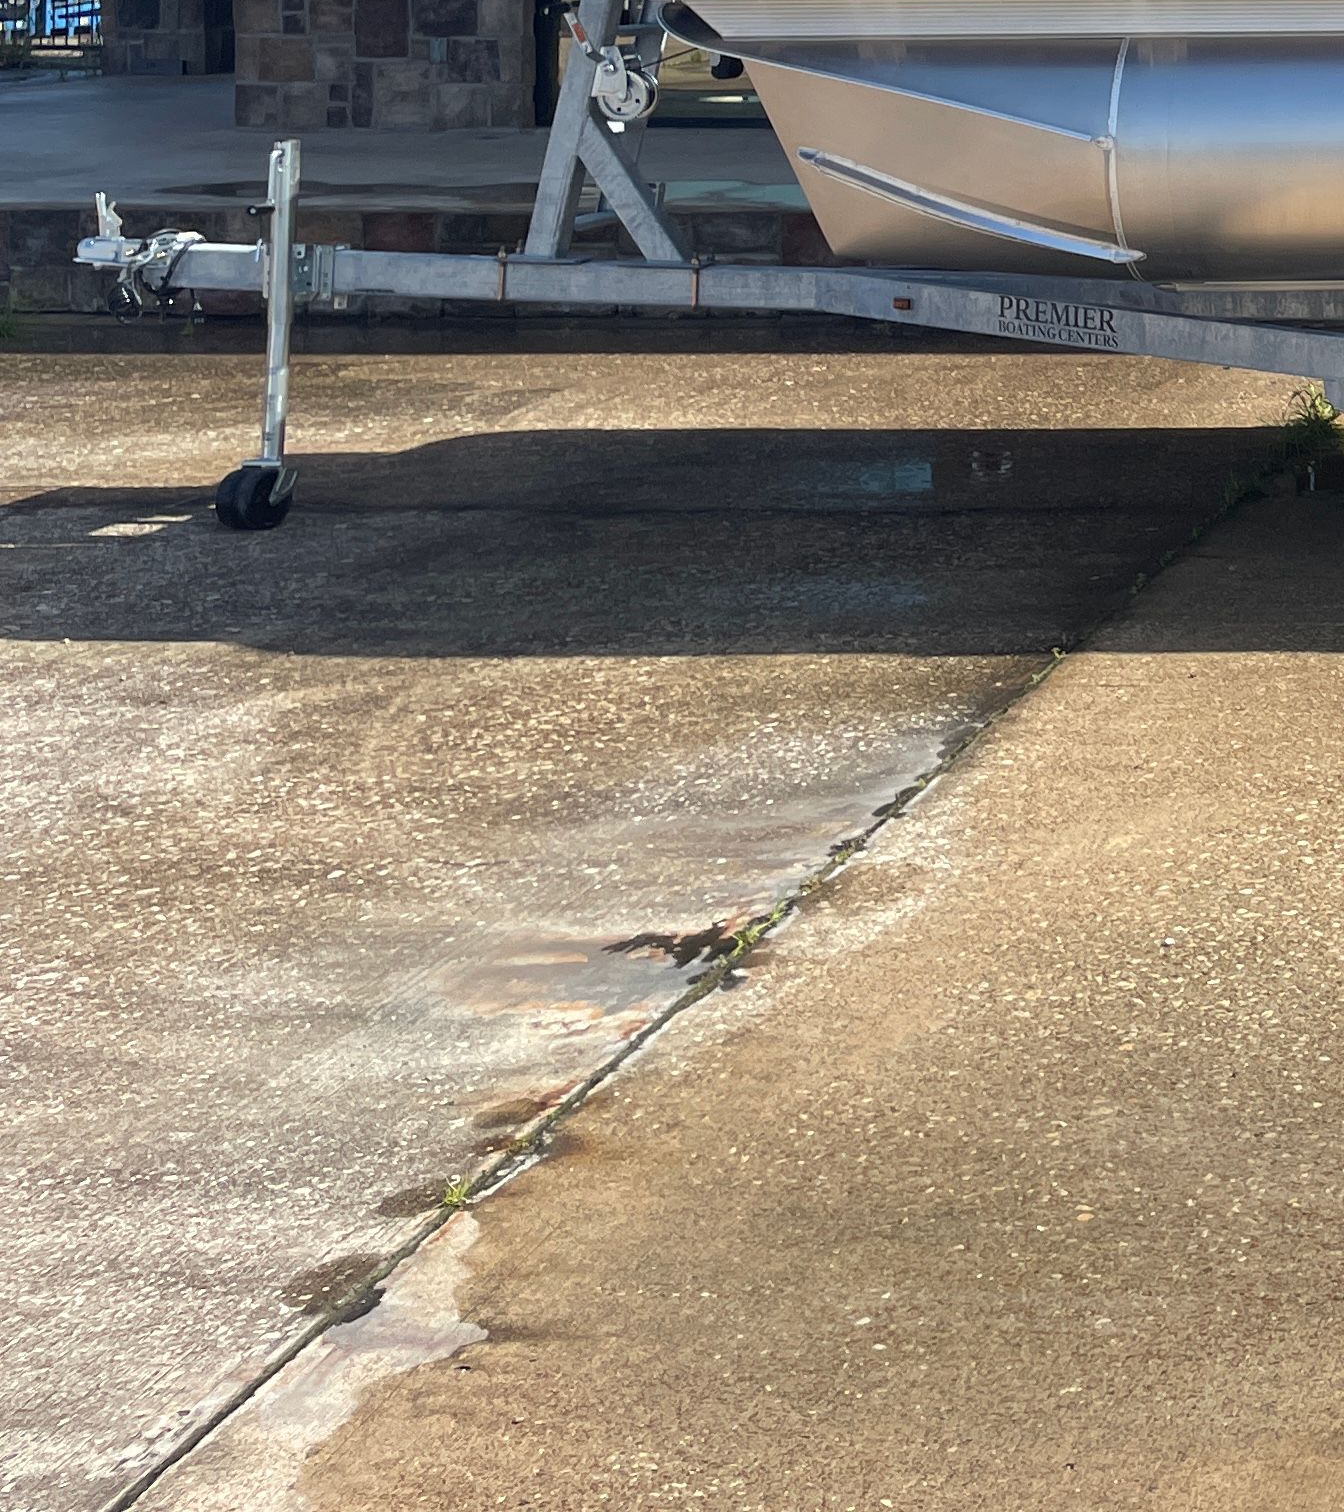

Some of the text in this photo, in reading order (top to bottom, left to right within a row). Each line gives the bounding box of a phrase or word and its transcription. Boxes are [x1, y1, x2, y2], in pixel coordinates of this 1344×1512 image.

[998, 295, 1118, 334] PREMIER
[998, 319, 1119, 349] BOATING CENTERS
